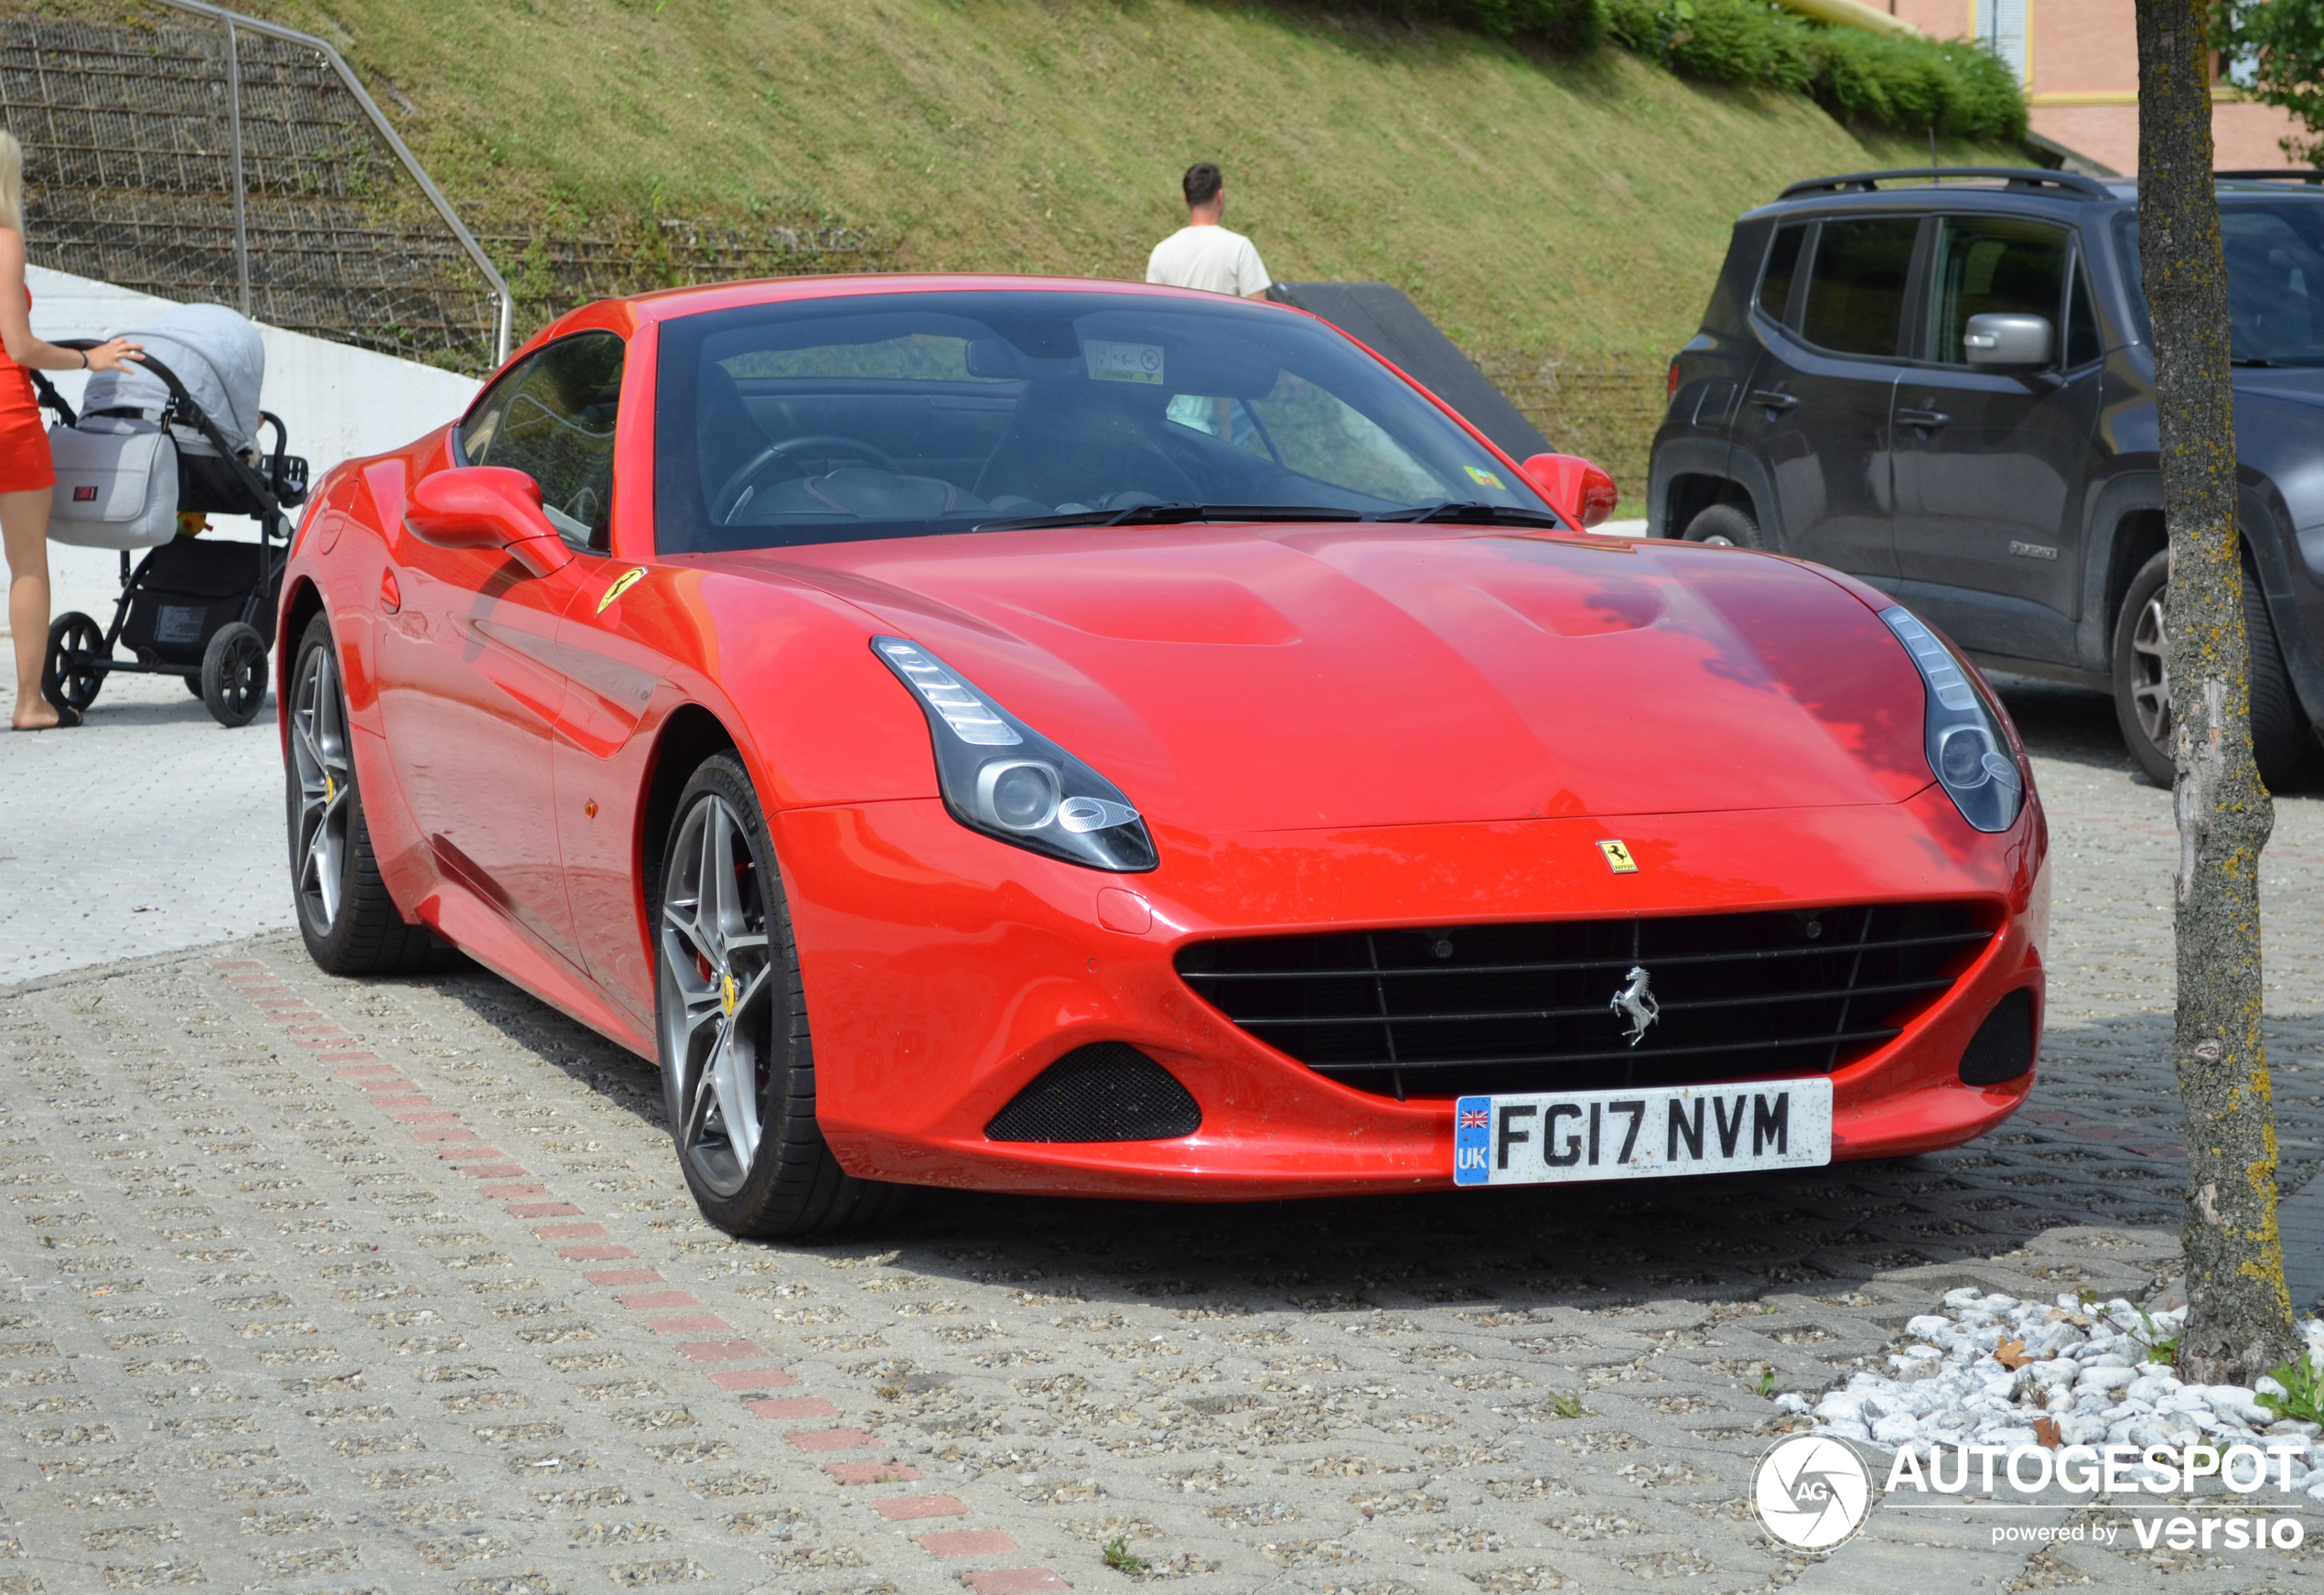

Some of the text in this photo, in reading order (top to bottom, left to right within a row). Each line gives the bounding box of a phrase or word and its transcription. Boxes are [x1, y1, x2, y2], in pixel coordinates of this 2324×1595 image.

[710, 770, 758, 829] MICHELIN
[1458, 1147, 1487, 1169] UK
[1498, 1093, 1789, 1169] FG17 NVM
